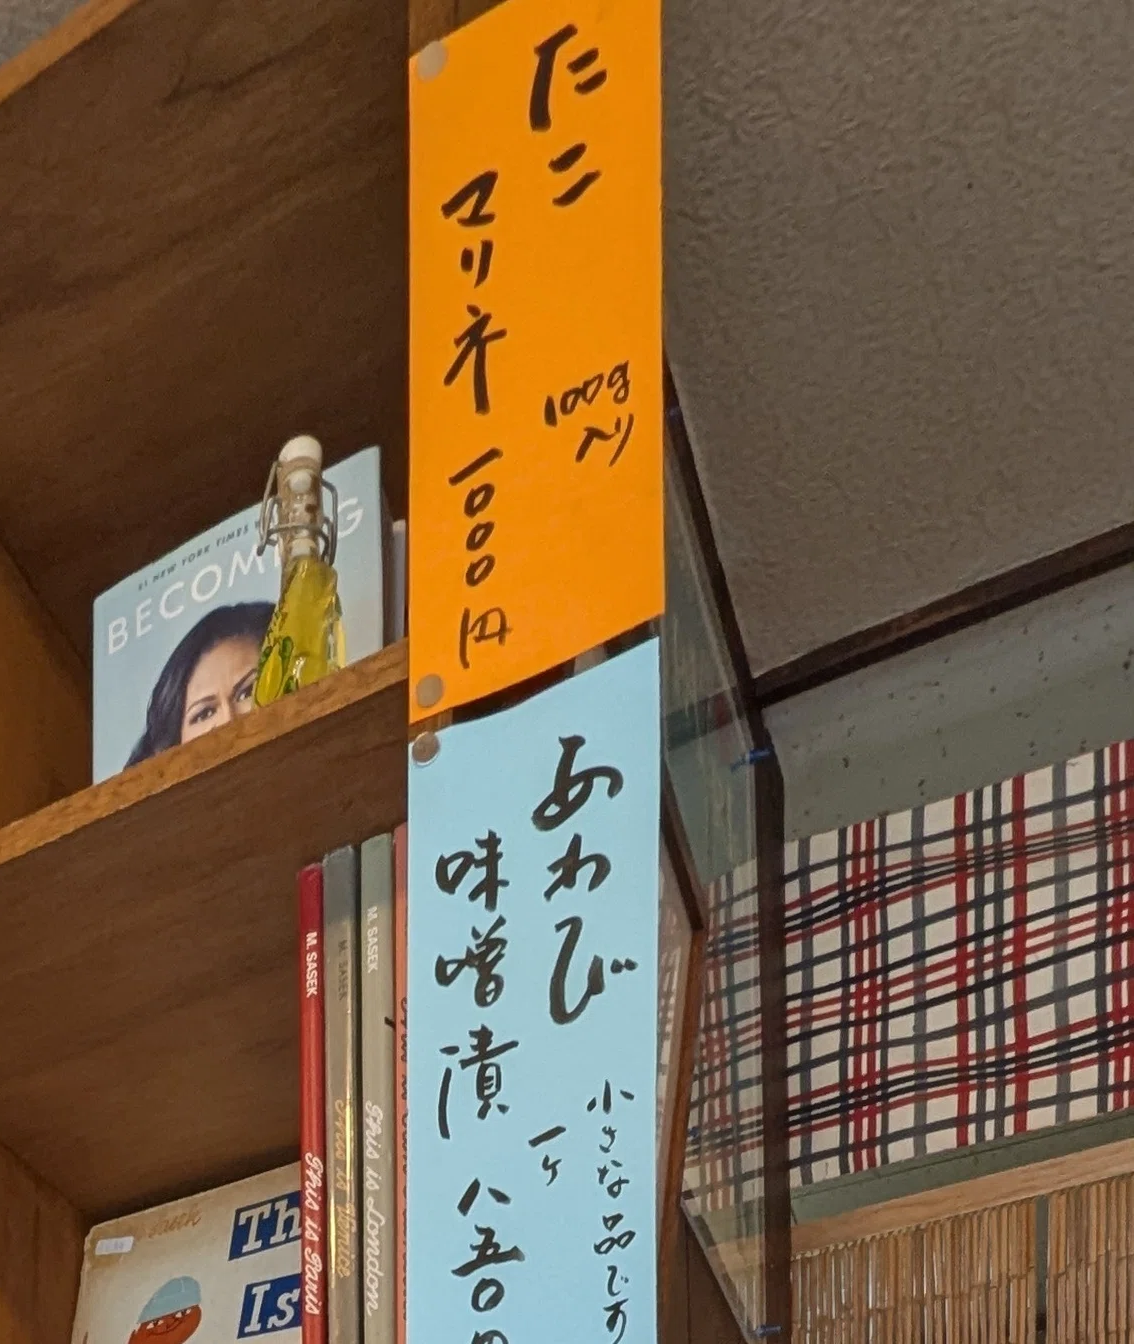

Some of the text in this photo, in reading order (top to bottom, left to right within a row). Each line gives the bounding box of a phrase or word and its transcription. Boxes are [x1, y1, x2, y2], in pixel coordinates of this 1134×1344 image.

[442, 170, 506, 414] マリネ
[544, 361, 630, 427] 100g
[107, 497, 364, 656] BECOMG
[152, 523, 250, 585] NEW YORK TIMES
[532, 735, 639, 1024] あわび
[305, 950, 318, 998] SASEK
[366, 924, 379, 974] SASEK
[435, 829, 519, 1140] 味噌漬
[365, 1100, 384, 1159] This
[304, 1151, 324, 1212] This
[365, 1167, 381, 1192] is
[304, 1216, 319, 1242] is
[365, 1196, 387, 1318] London
[244, 1283, 300, 1334] Is
[304, 1247, 323, 1316] Paris
